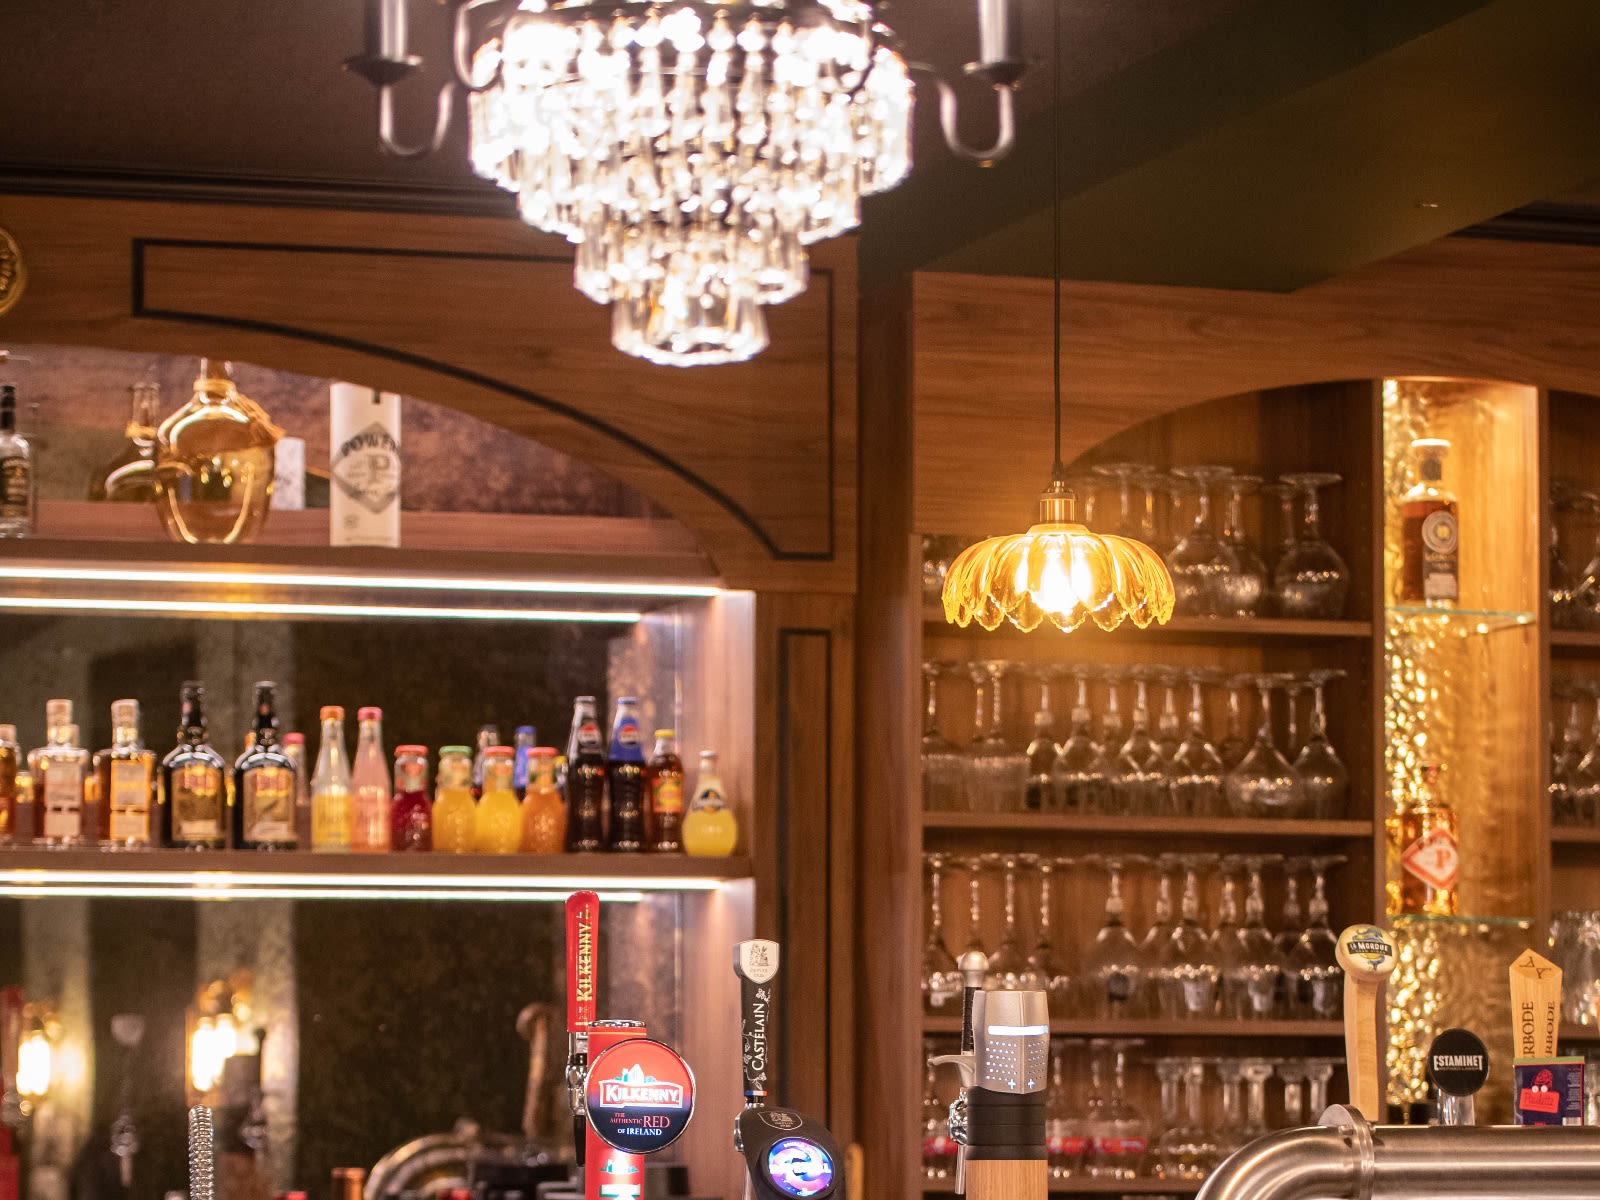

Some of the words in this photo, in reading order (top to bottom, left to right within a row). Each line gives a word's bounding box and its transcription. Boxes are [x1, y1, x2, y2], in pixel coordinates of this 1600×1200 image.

[576, 922, 593, 1002] KILKENNY
[752, 1003, 765, 1071] CASTELAIN
[1522, 1001, 1535, 1058] RBODE
[1545, 1001, 1556, 1057] RBODE
[1433, 1055, 1483, 1070] ESTAMINET
[605, 1084, 680, 1103] KILKENNY
[610, 1117, 642, 1125] AUTHENTIC
[643, 1115, 670, 1128] RED
[626, 1127, 662, 1136] IRELAND
